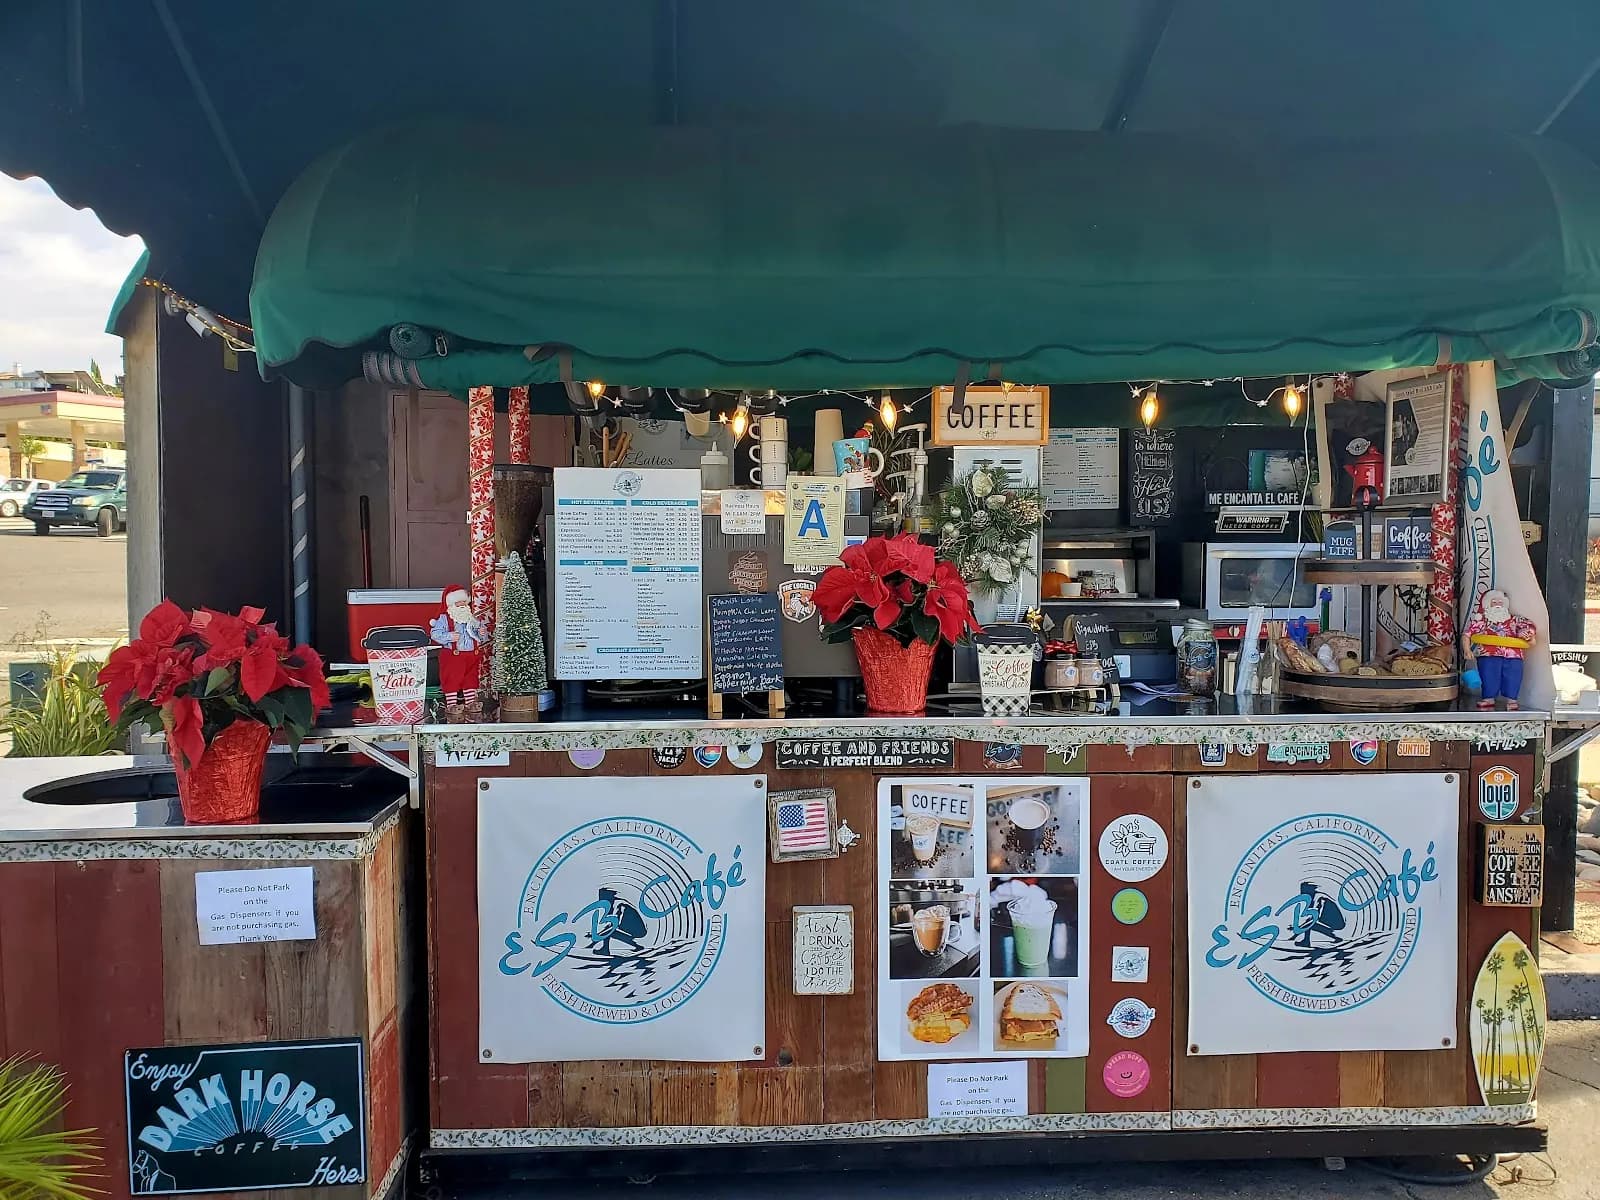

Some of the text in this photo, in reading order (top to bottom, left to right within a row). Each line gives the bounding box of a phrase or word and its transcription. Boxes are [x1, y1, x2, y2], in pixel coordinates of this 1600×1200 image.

[947, 404, 1035, 429] COFFEE
[1209, 493, 1222, 504] ME
[1224, 493, 1263, 504] ENCANTA
[1265, 493, 1275, 504] EL
[798, 500, 829, 538] A
[1236, 516, 1270, 524] WARNING
[1331, 537, 1353, 546] MUG
[1389, 525, 1431, 550] Coffee
[1329, 547, 1354, 556] LIFE
[1474, 517, 1490, 594] OWNED
[713, 608, 742, 617] Pumpkin
[1552, 653, 1589, 663] FRESHLY
[991, 659, 1031, 676] Coffee
[379, 672, 416, 689] Latte
[782, 741, 950, 755] COFFEE AND FRIENDS
[1398, 743, 1430, 755] SUNTIDE
[823, 756, 902, 766] A PERFECT BLEND
[912, 794, 968, 815] COFFEE
[523, 821, 692, 915] ENCINITAS, CALIFORNIA
[1229, 818, 1388, 909] ENCINITAS, CALIFORNIA
[1489, 854, 1540, 872] COFFEE
[273, 883, 290, 891] Park
[1488, 873, 1540, 885] IS THE
[1488, 887, 1539, 903] ANSWER
[499, 845, 746, 977] ESB Café
[1205, 841, 1439, 969] ESB Café
[230, 911, 272, 919] Dispensers
[241, 921, 283, 930] purchasing
[809, 935, 849, 949] DRINK
[1247, 907, 1417, 1010] FRESH BREWED & LOCALLY OWNED
[542, 914, 724, 1021] FRESH BREWED & LOCALLY OWNED
[811, 967, 824, 975] DO
[827, 967, 844, 975] THE
[129, 1053, 197, 1091] Enjoy
[138, 1069, 354, 1152] DARK HORSE
[965, 1107, 1000, 1116] purchasing
[194, 1139, 299, 1157] COFFEE
